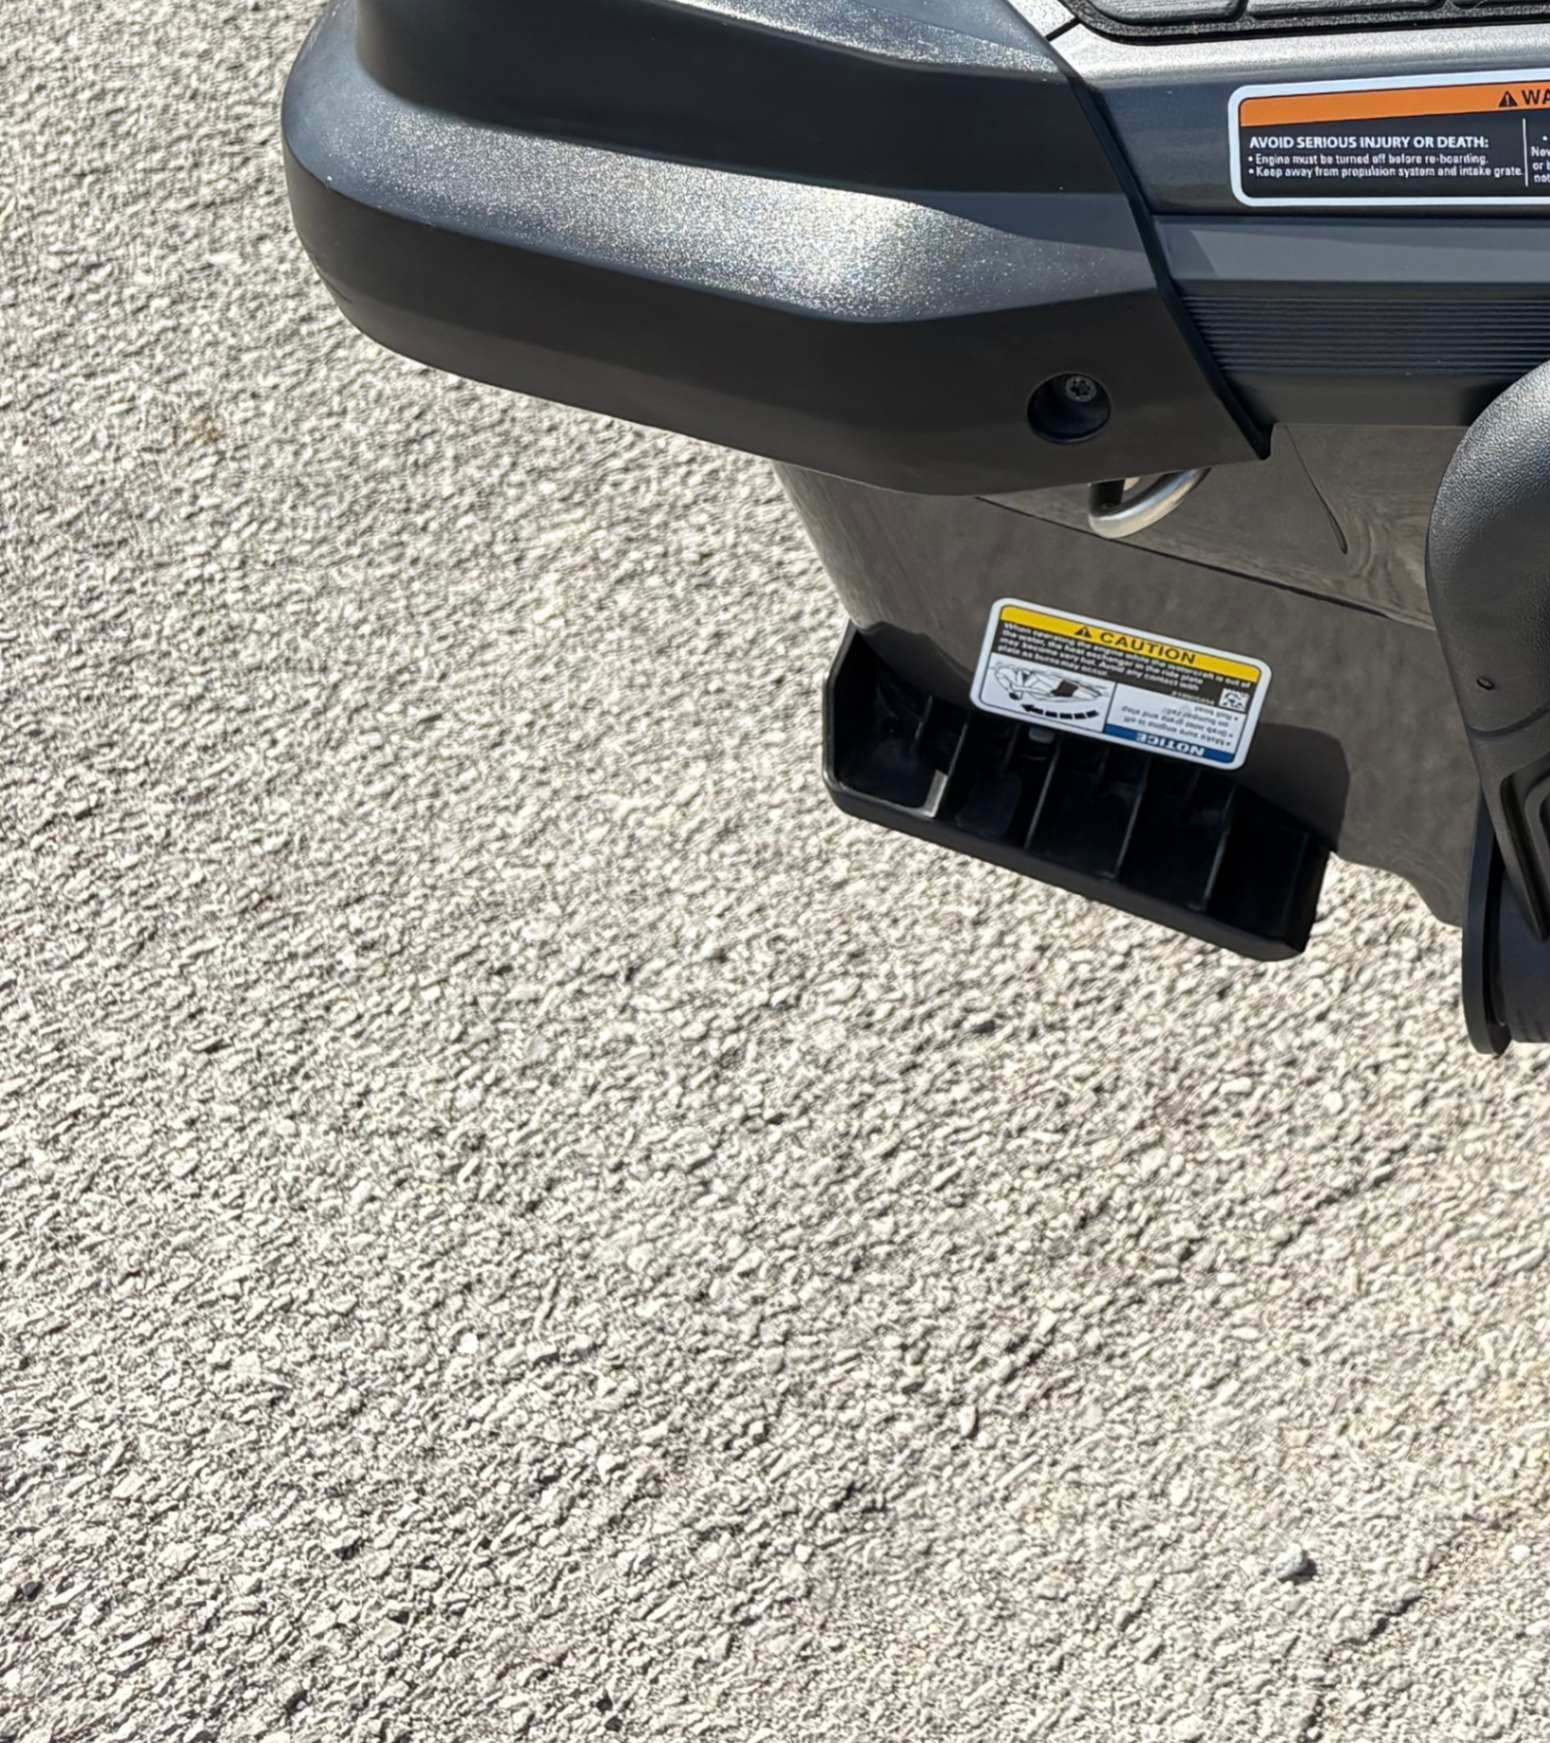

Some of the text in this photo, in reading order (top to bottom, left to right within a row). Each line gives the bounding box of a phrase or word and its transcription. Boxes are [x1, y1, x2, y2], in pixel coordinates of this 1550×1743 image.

[1249, 136, 1488, 148] AVOID SERIOUS INJURY OR DEATH:
[1098, 631, 1196, 665] CAUTION
[1135, 730, 1205, 757] NOTICE
